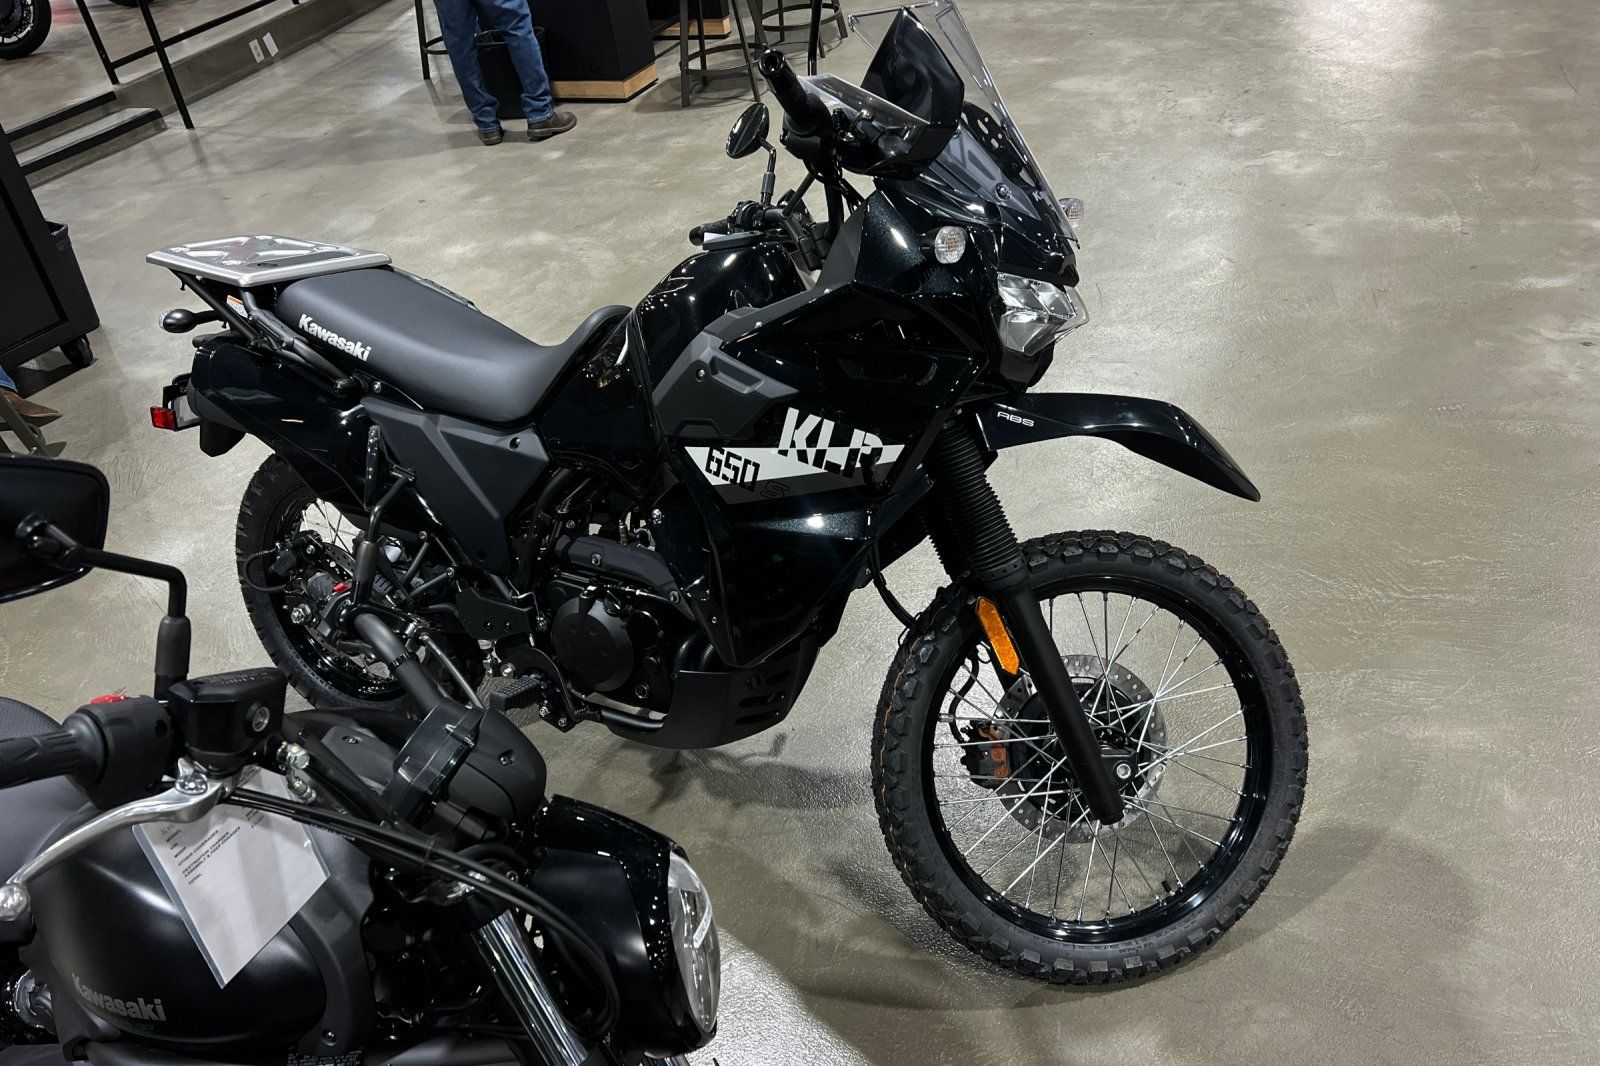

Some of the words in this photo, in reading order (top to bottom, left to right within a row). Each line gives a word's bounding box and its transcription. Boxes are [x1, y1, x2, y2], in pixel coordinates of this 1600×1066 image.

[298, 314, 371, 361] Kawasaki
[997, 411, 1034, 426] ABS
[776, 407, 883, 484] KLR
[705, 447, 760, 492] 650
[71, 972, 166, 1021] Kawasaki
